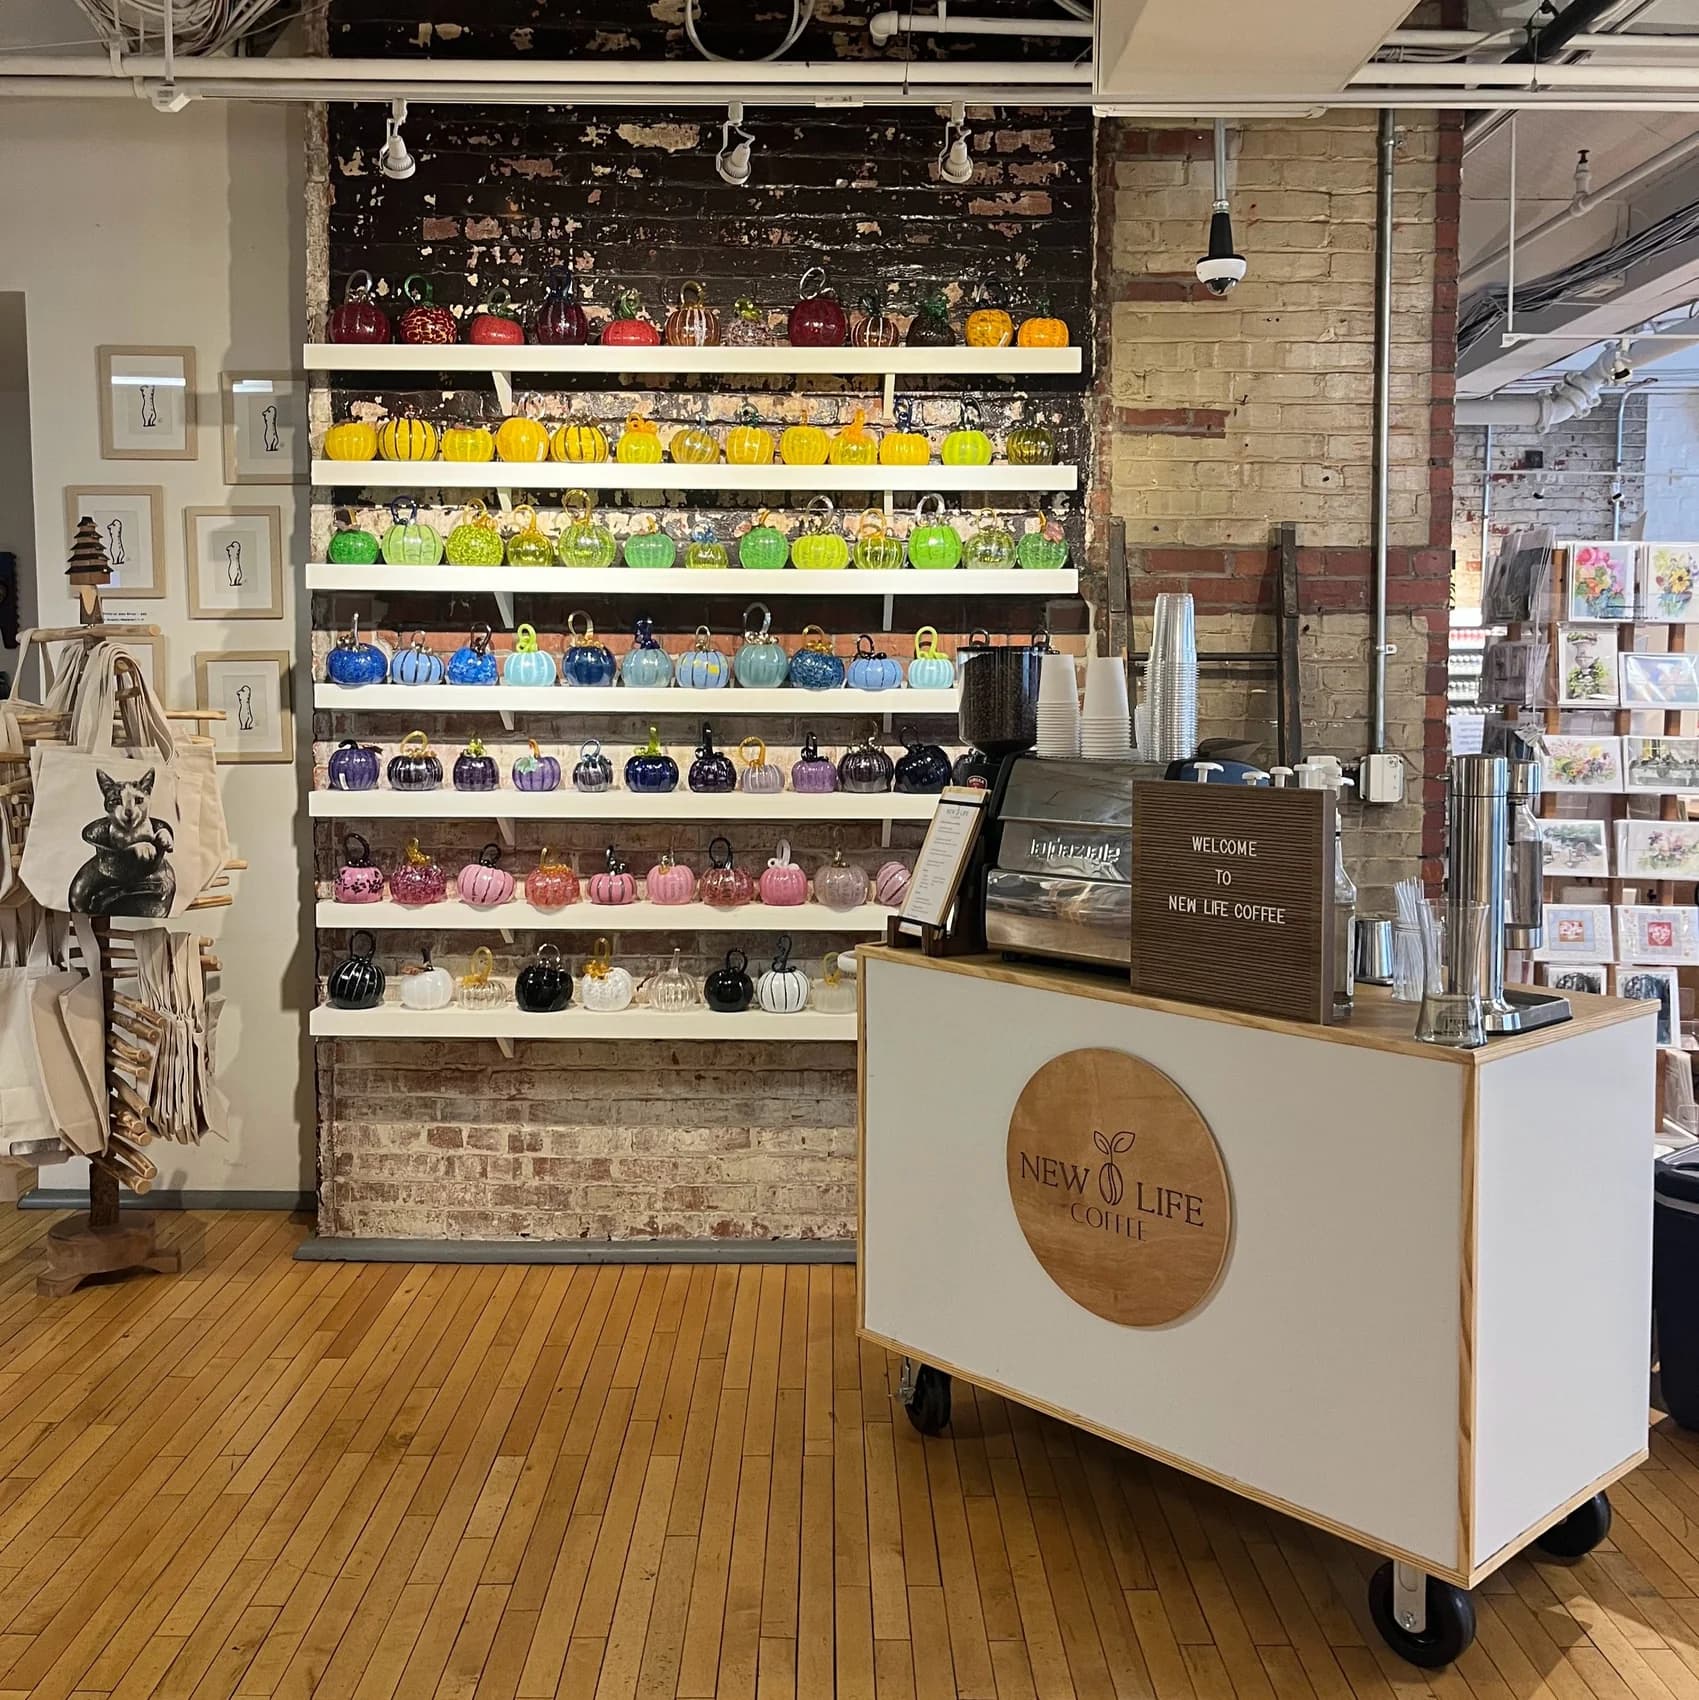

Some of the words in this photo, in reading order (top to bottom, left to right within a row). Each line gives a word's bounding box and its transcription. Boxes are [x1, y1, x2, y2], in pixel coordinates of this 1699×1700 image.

[1192, 836, 1257, 856] WELCOME
[1215, 869, 1232, 886] TO
[1168, 895, 1196, 913] NEW
[1203, 899, 1229, 917] LIFE
[1234, 903, 1286, 924] COFFEE
[1020, 1151, 1090, 1194] NEW
[1136, 1182, 1204, 1227] LIFE
[1070, 1202, 1147, 1242] COFFEE
